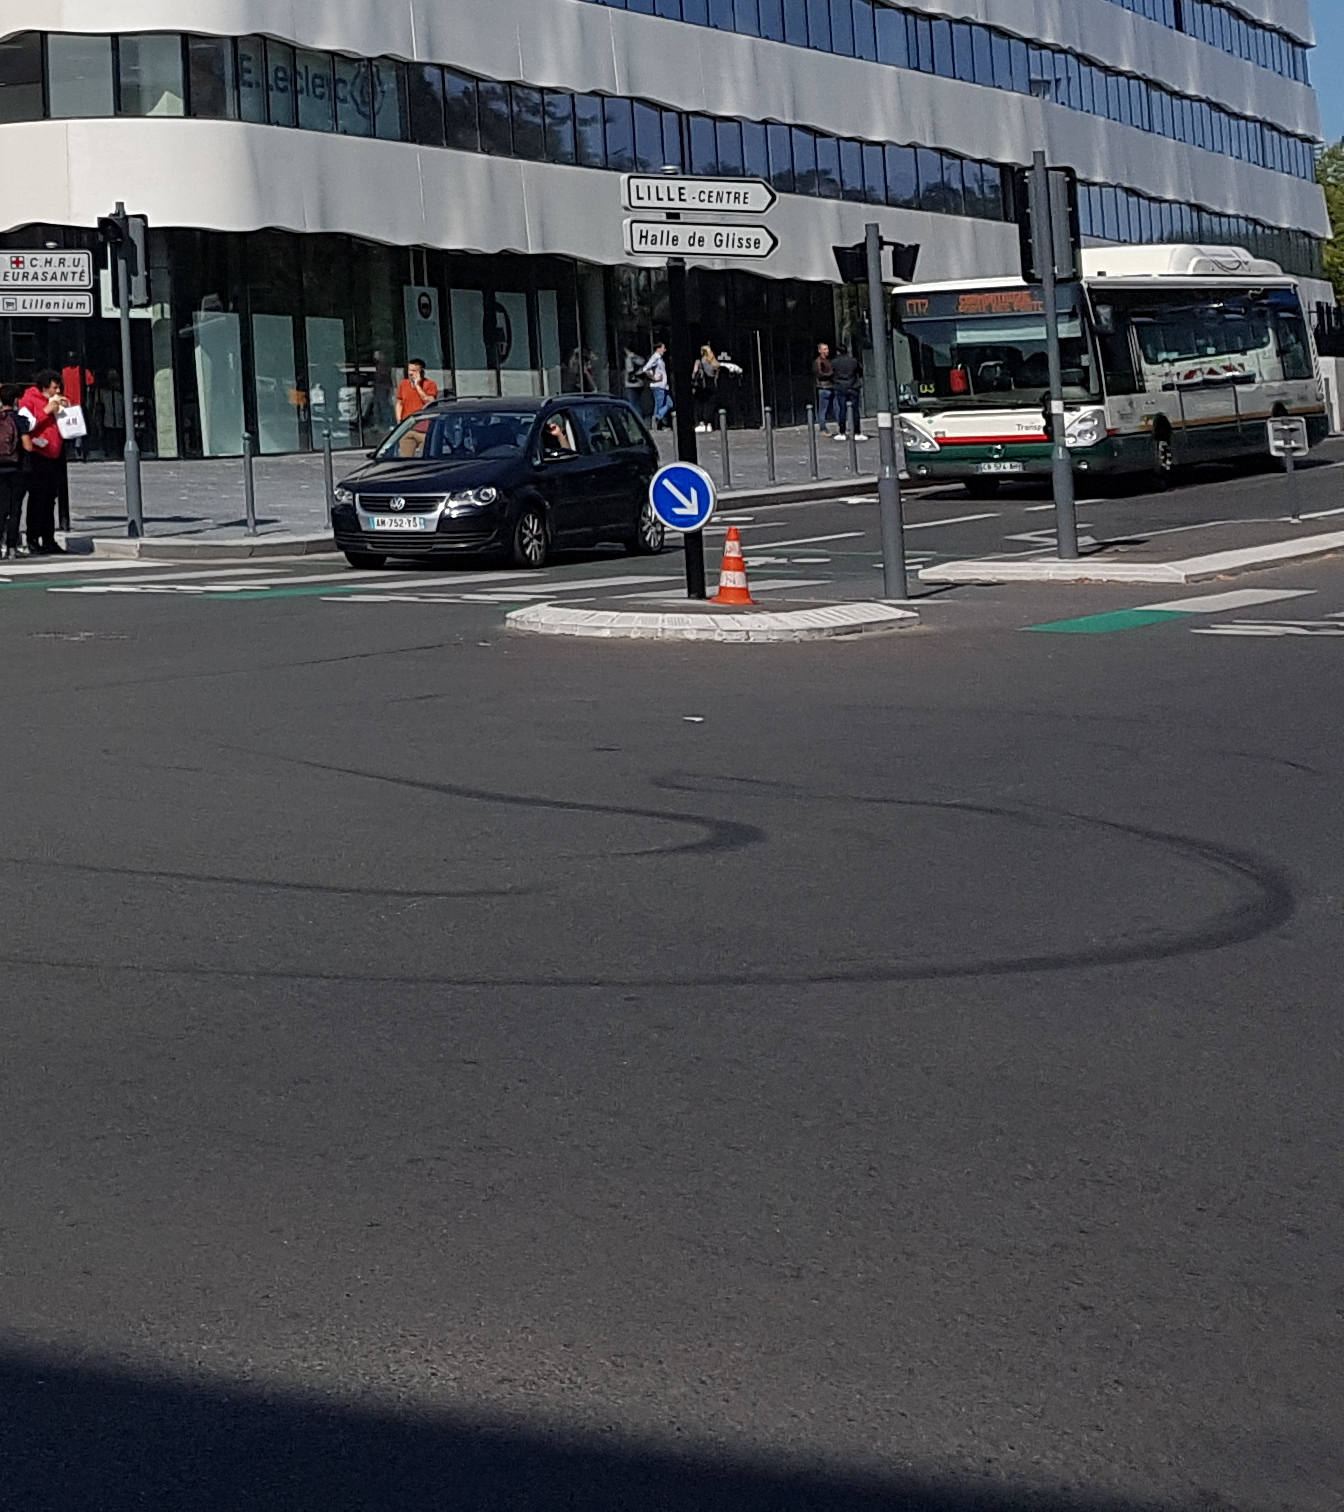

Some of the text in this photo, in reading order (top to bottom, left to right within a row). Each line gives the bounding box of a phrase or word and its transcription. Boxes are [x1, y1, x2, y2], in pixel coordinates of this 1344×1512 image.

[238, 52, 349, 104] E.eclerc
[639, 229, 761, 250] Halle de Glisse
[29, 257, 85, 268] C.H.R.U.
[2, 268, 86, 282] EURASANTÉ
